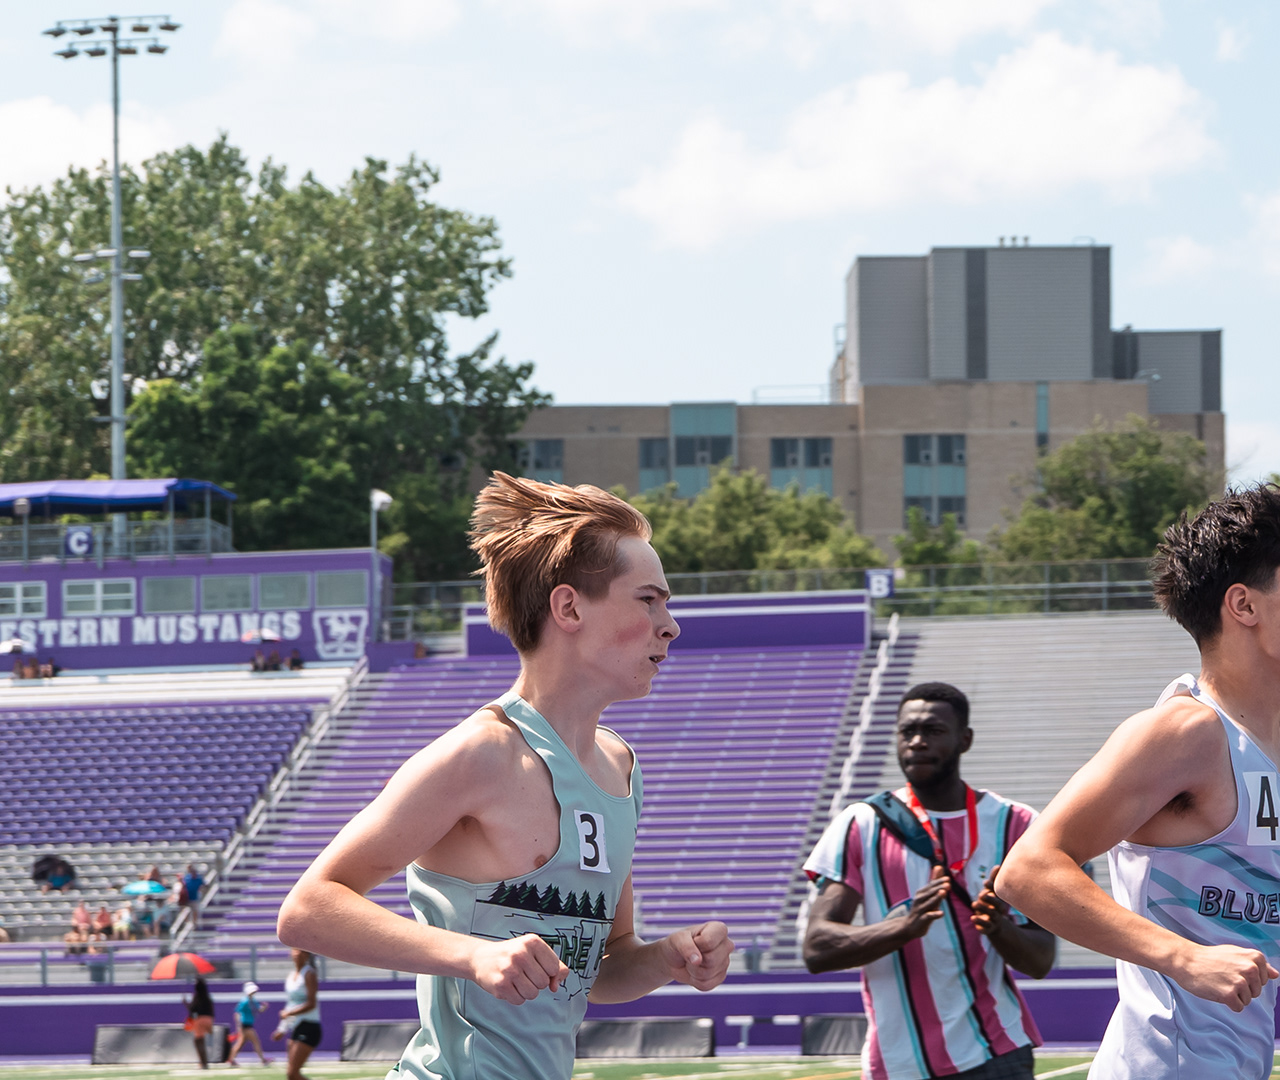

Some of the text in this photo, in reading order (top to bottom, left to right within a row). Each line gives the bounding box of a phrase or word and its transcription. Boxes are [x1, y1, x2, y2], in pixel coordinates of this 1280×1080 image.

[69, 531, 89, 555] C
[132, 611, 302, 645] MUSTANGS
[1256, 776, 1279, 841] 4
[580, 813, 600, 868] 3
